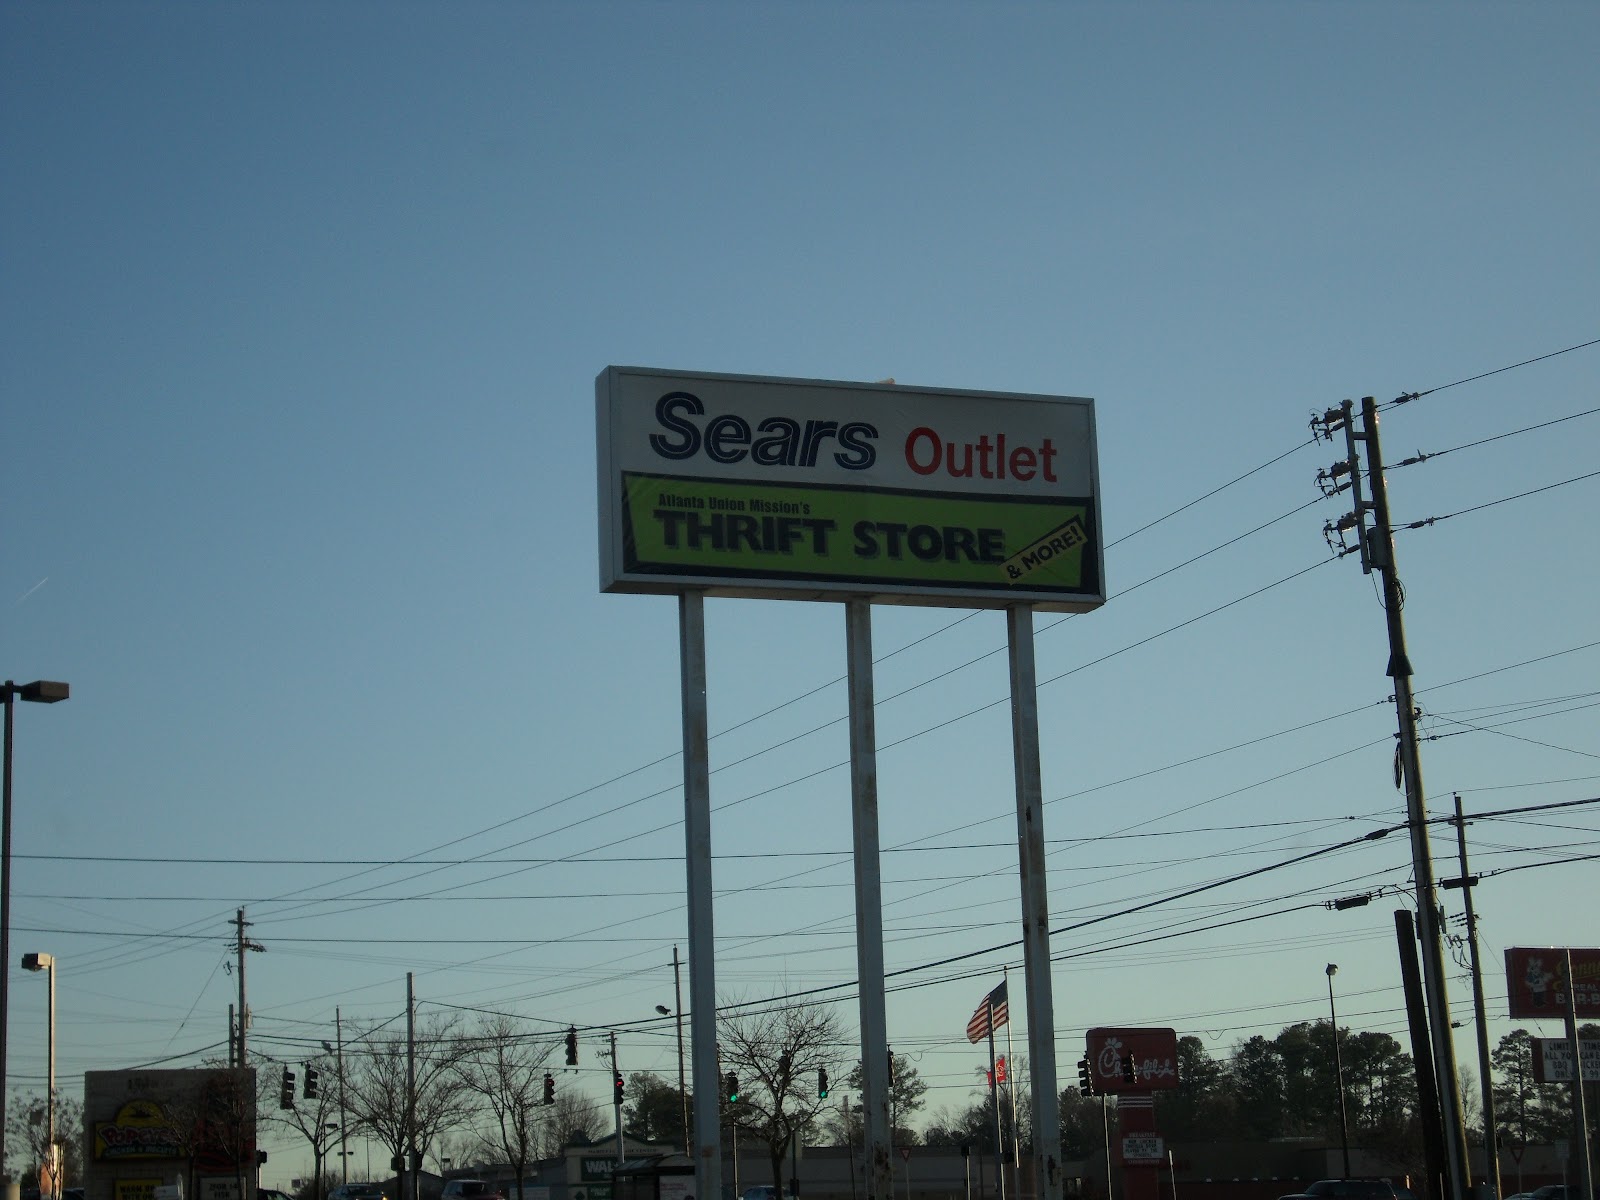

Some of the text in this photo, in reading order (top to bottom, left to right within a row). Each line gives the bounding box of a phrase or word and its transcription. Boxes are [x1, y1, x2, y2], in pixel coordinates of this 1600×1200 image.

[649, 391, 1058, 483] Sears Outlet
[658, 493, 811, 515] Atlanta Union Mission's
[652, 509, 1005, 563] THRIFT STORE
[1005, 525, 1083, 580] & MORE!
